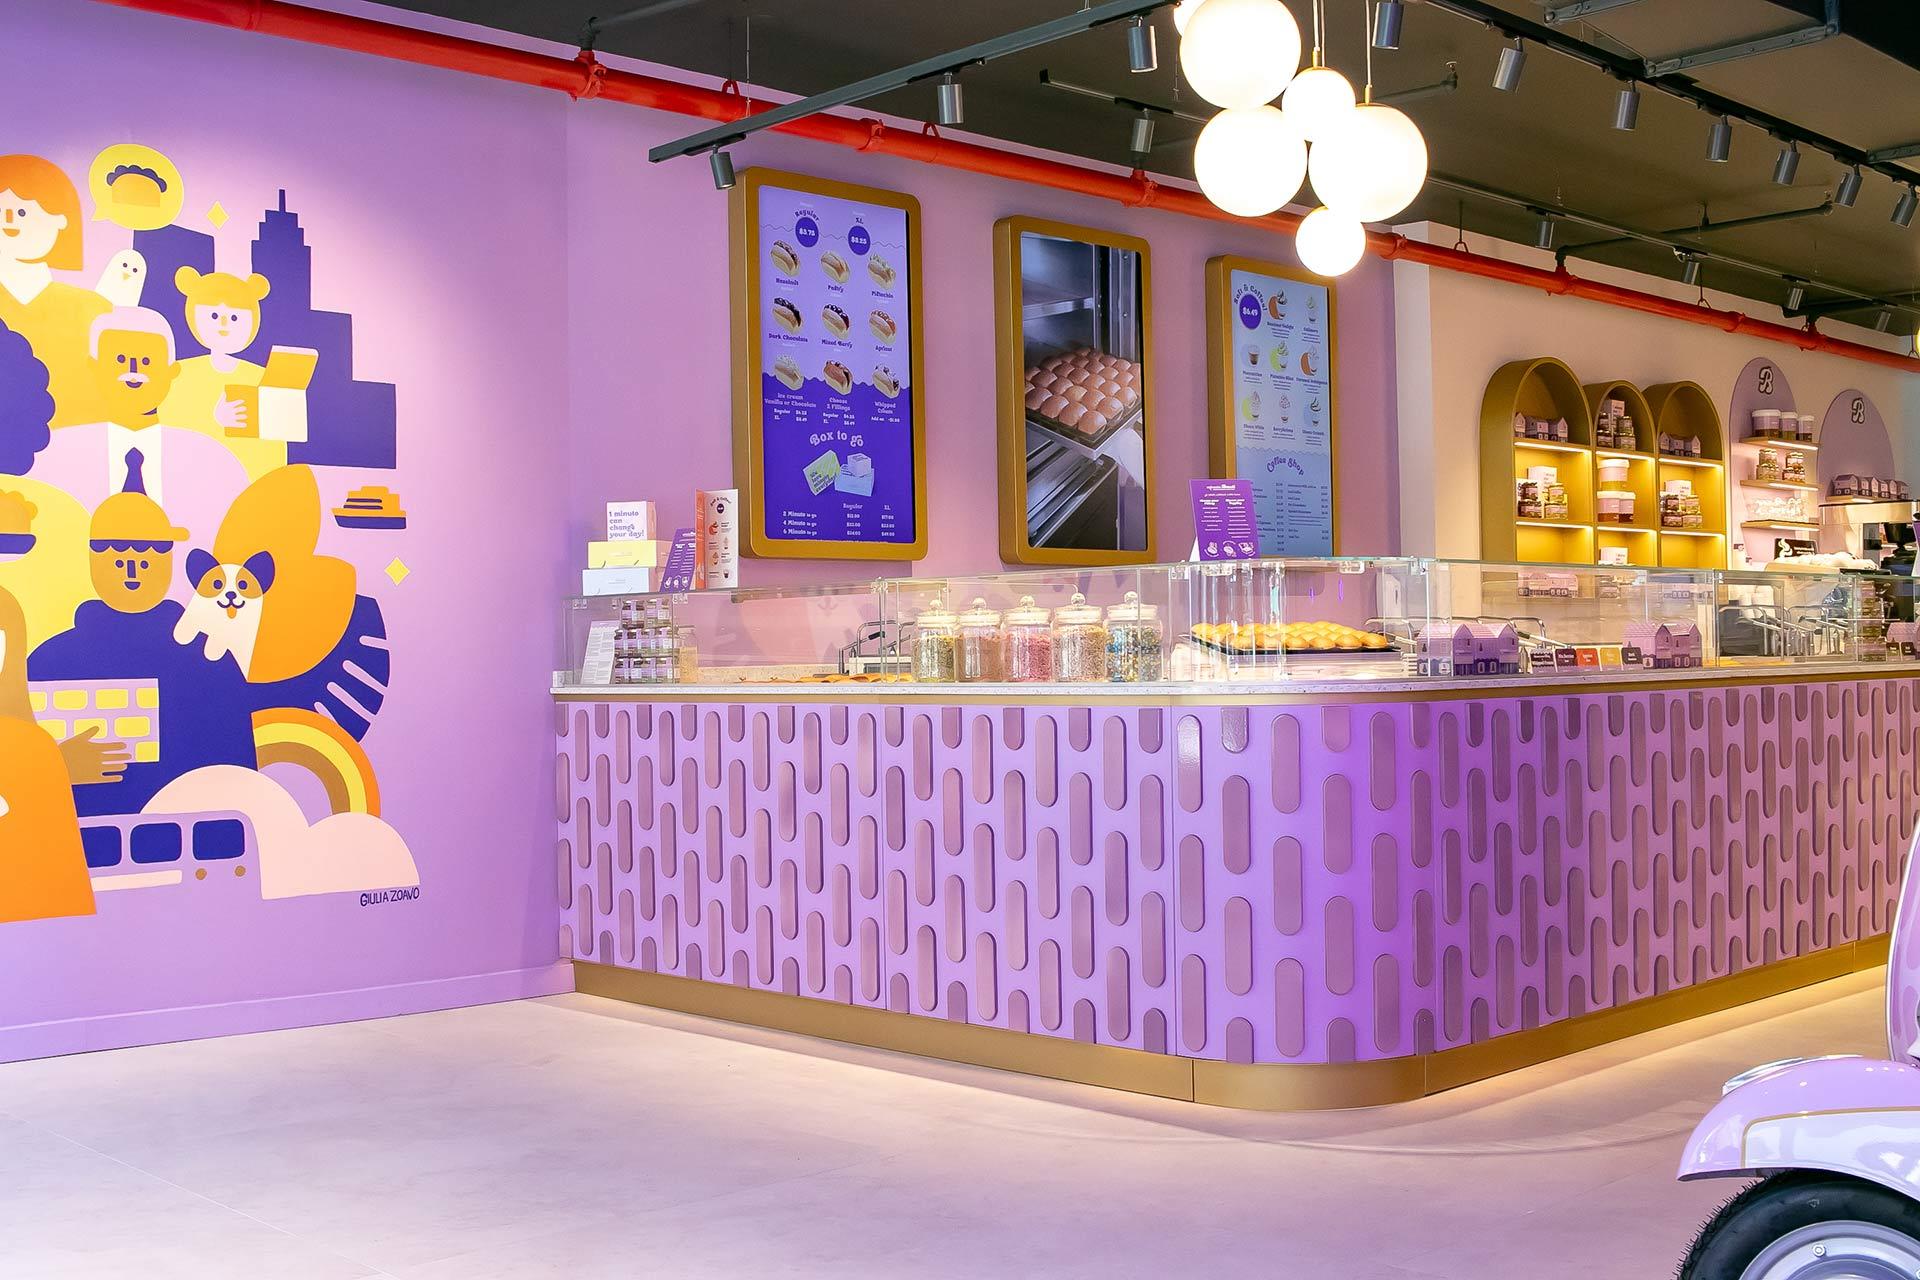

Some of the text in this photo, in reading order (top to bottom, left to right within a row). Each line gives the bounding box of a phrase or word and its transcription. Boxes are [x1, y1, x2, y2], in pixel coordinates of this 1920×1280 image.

[795, 209, 820, 221] Regular
[809, 430, 864, 447] Box to go
[1266, 456, 1305, 476] Coffee Shop
[609, 531, 627, 539] your
[360, 887, 420, 907] GIULIA ZOAVO
